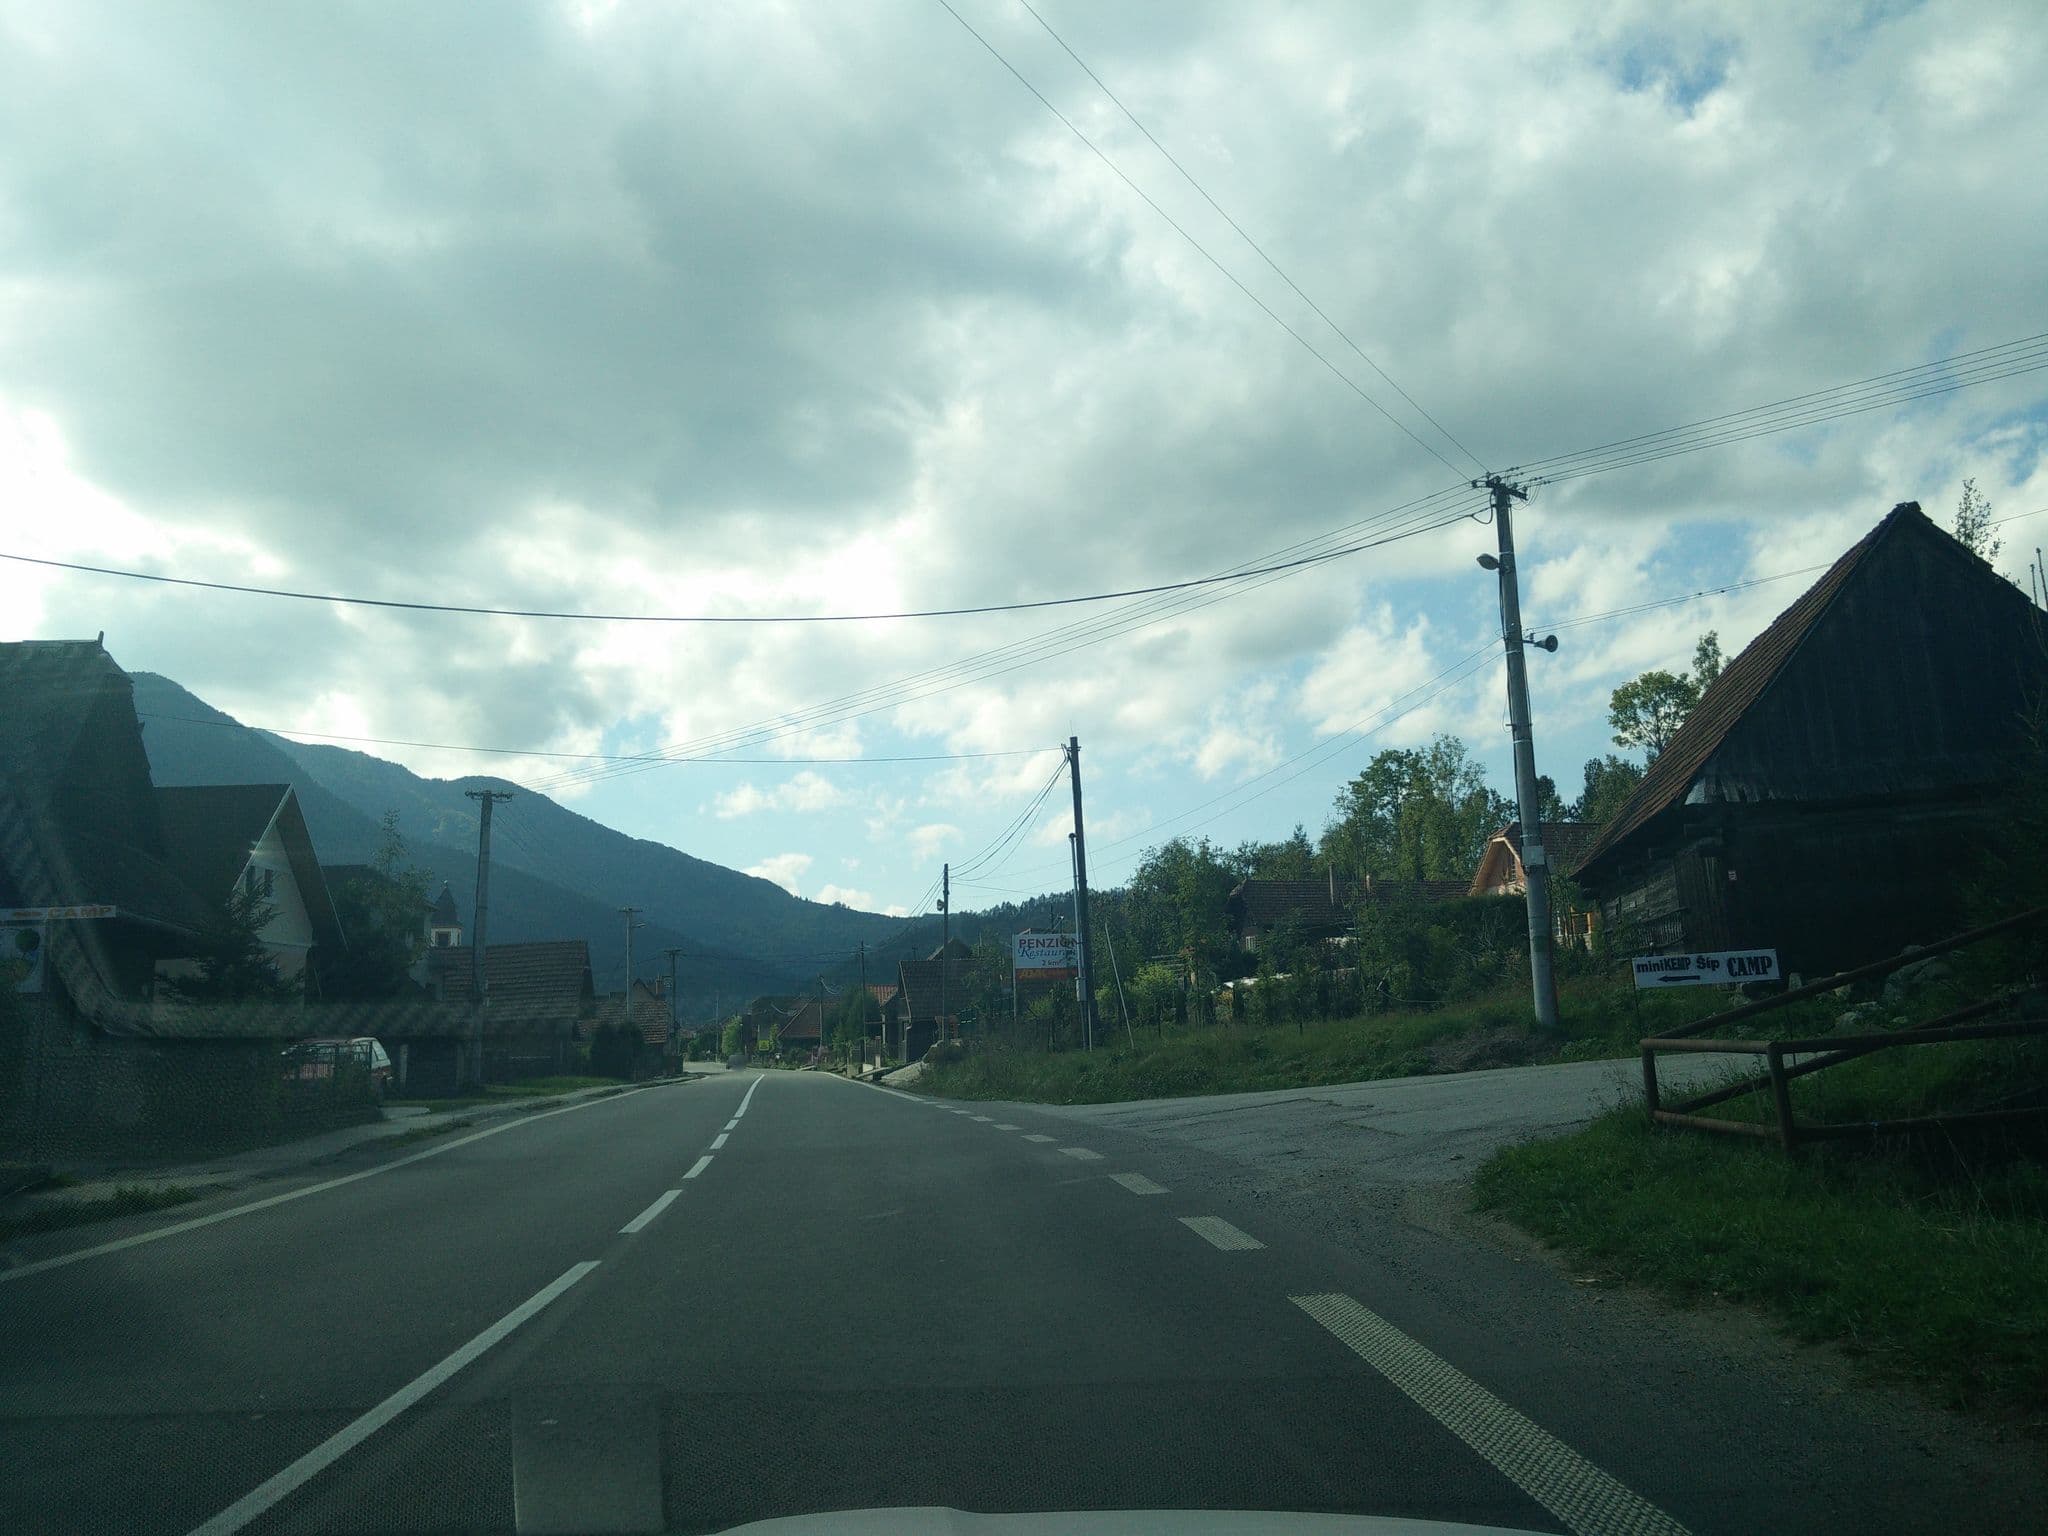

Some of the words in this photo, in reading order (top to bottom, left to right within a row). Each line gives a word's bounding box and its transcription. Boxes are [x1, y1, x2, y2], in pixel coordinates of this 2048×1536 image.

[48, 906, 111, 918] CAMP
[1636, 957, 1691, 973] miniKEMP
[1727, 955, 1773, 977] CAMP
